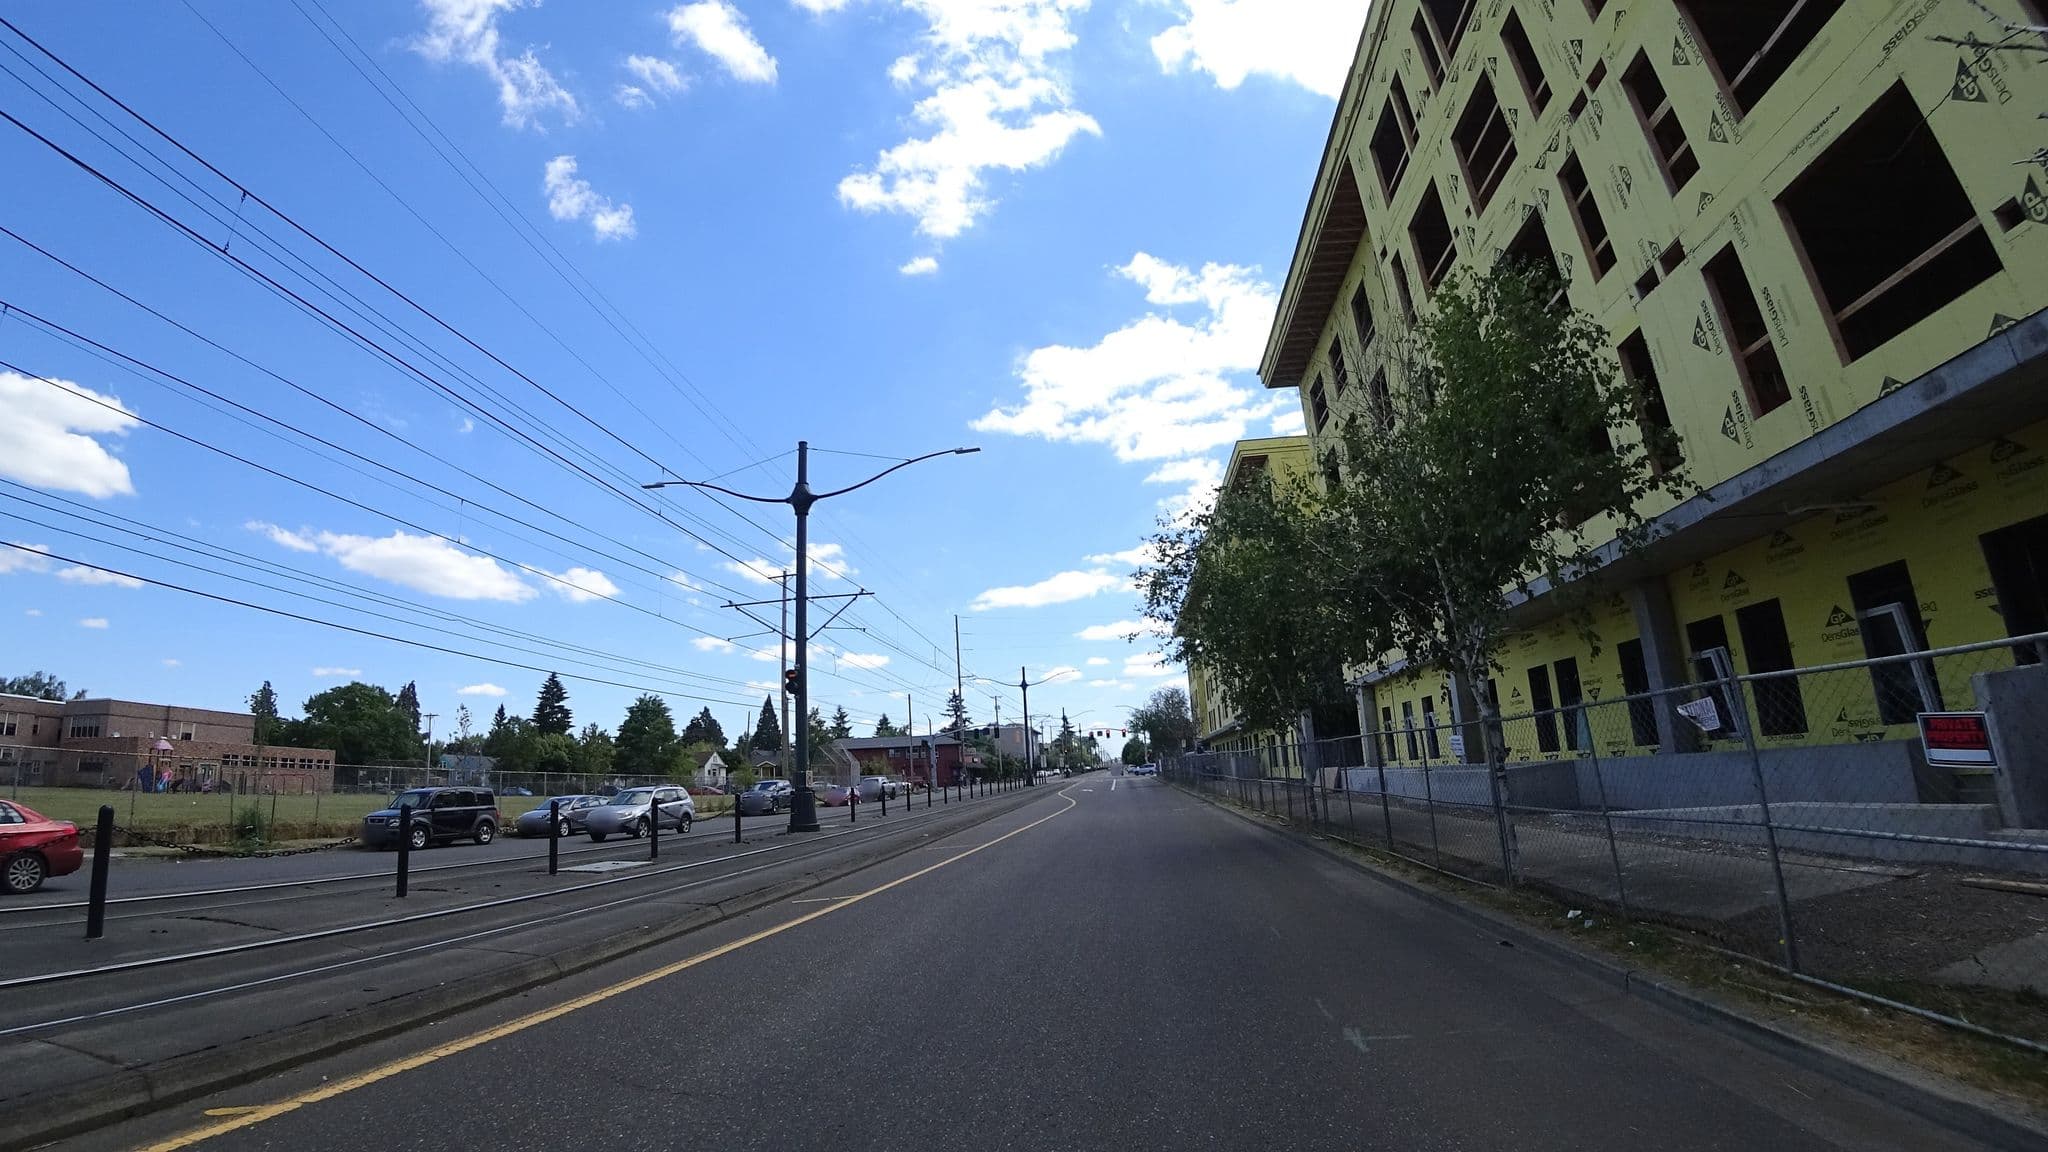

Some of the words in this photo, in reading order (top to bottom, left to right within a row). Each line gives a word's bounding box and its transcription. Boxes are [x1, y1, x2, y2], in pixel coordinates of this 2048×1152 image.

[1695, 327, 1707, 347] GP
[1700, 299, 1723, 356] DensGlass
[1761, 285, 1790, 349] DensGlass
[1725, 416, 1737, 438] GP
[1731, 389, 1754, 451] DensGlass
[1799, 384, 1820, 433] nsGlass
[1821, 627, 1860, 642] DensGlas
